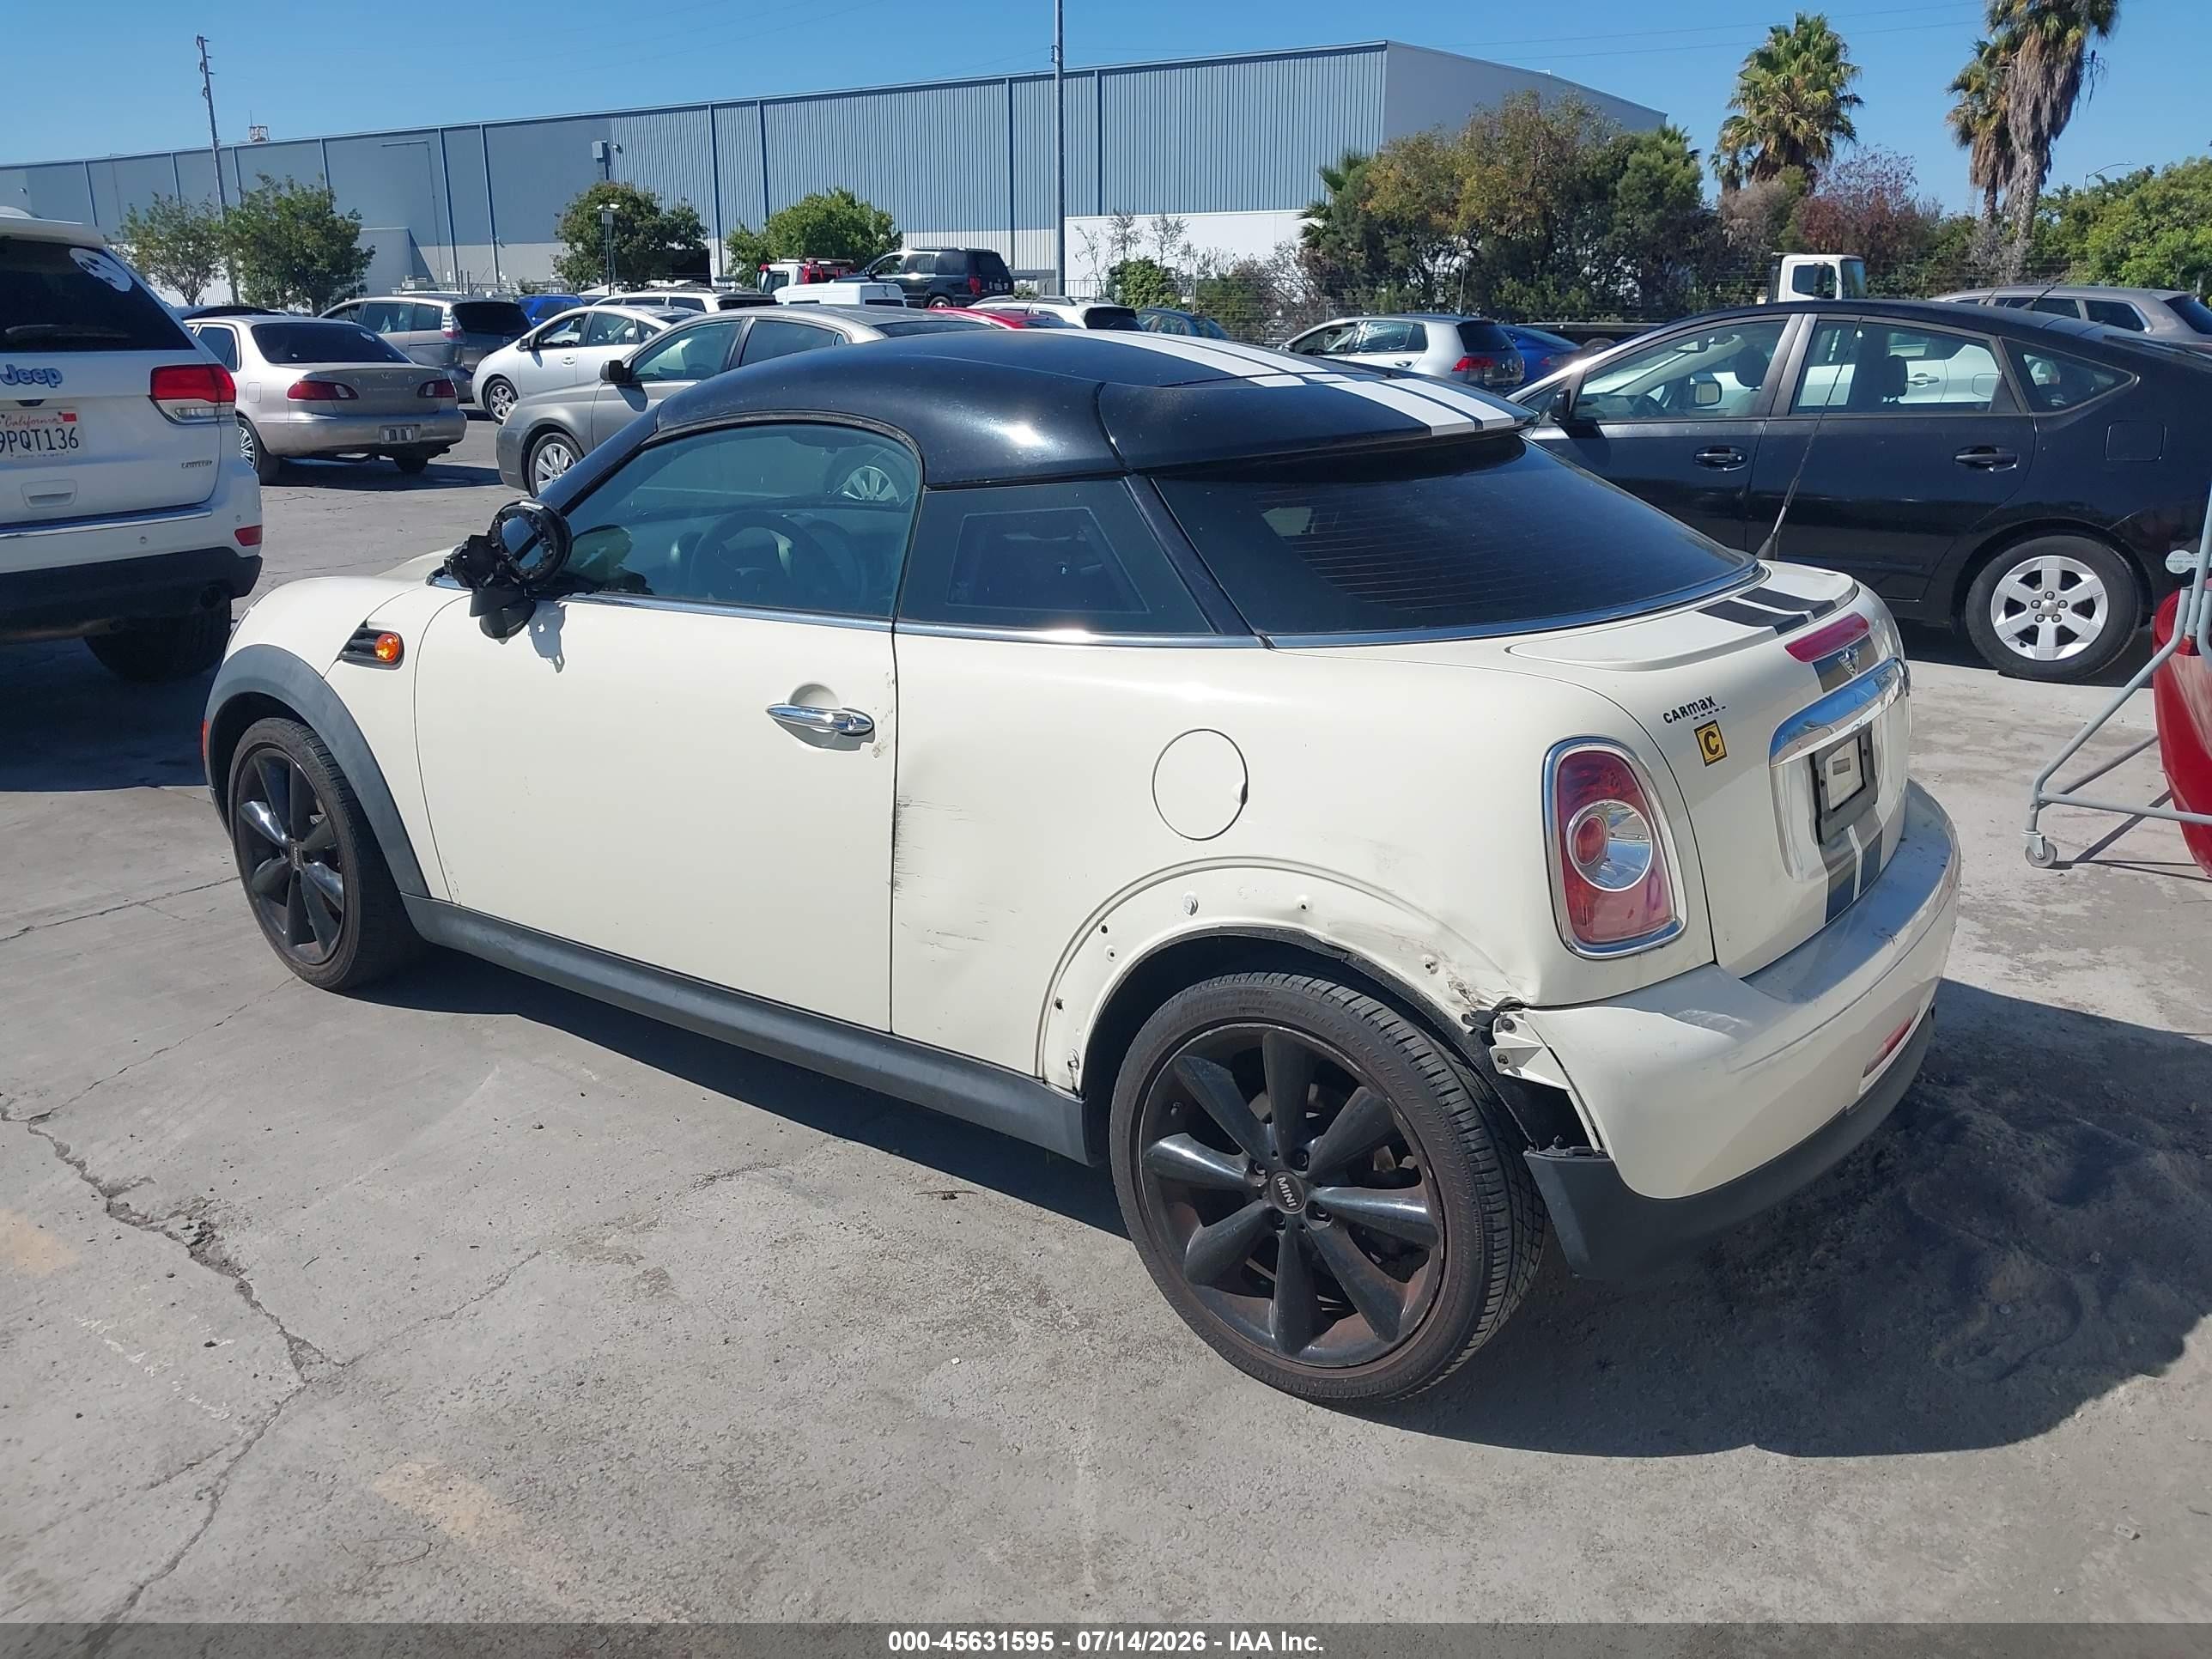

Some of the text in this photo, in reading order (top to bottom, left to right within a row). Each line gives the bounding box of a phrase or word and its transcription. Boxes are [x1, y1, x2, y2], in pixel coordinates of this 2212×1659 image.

[0, 364, 63, 388] Jeep
[5, 415, 59, 428] California
[1704, 730, 1720, 756] C
[1277, 1176, 1297, 1207] MINI
